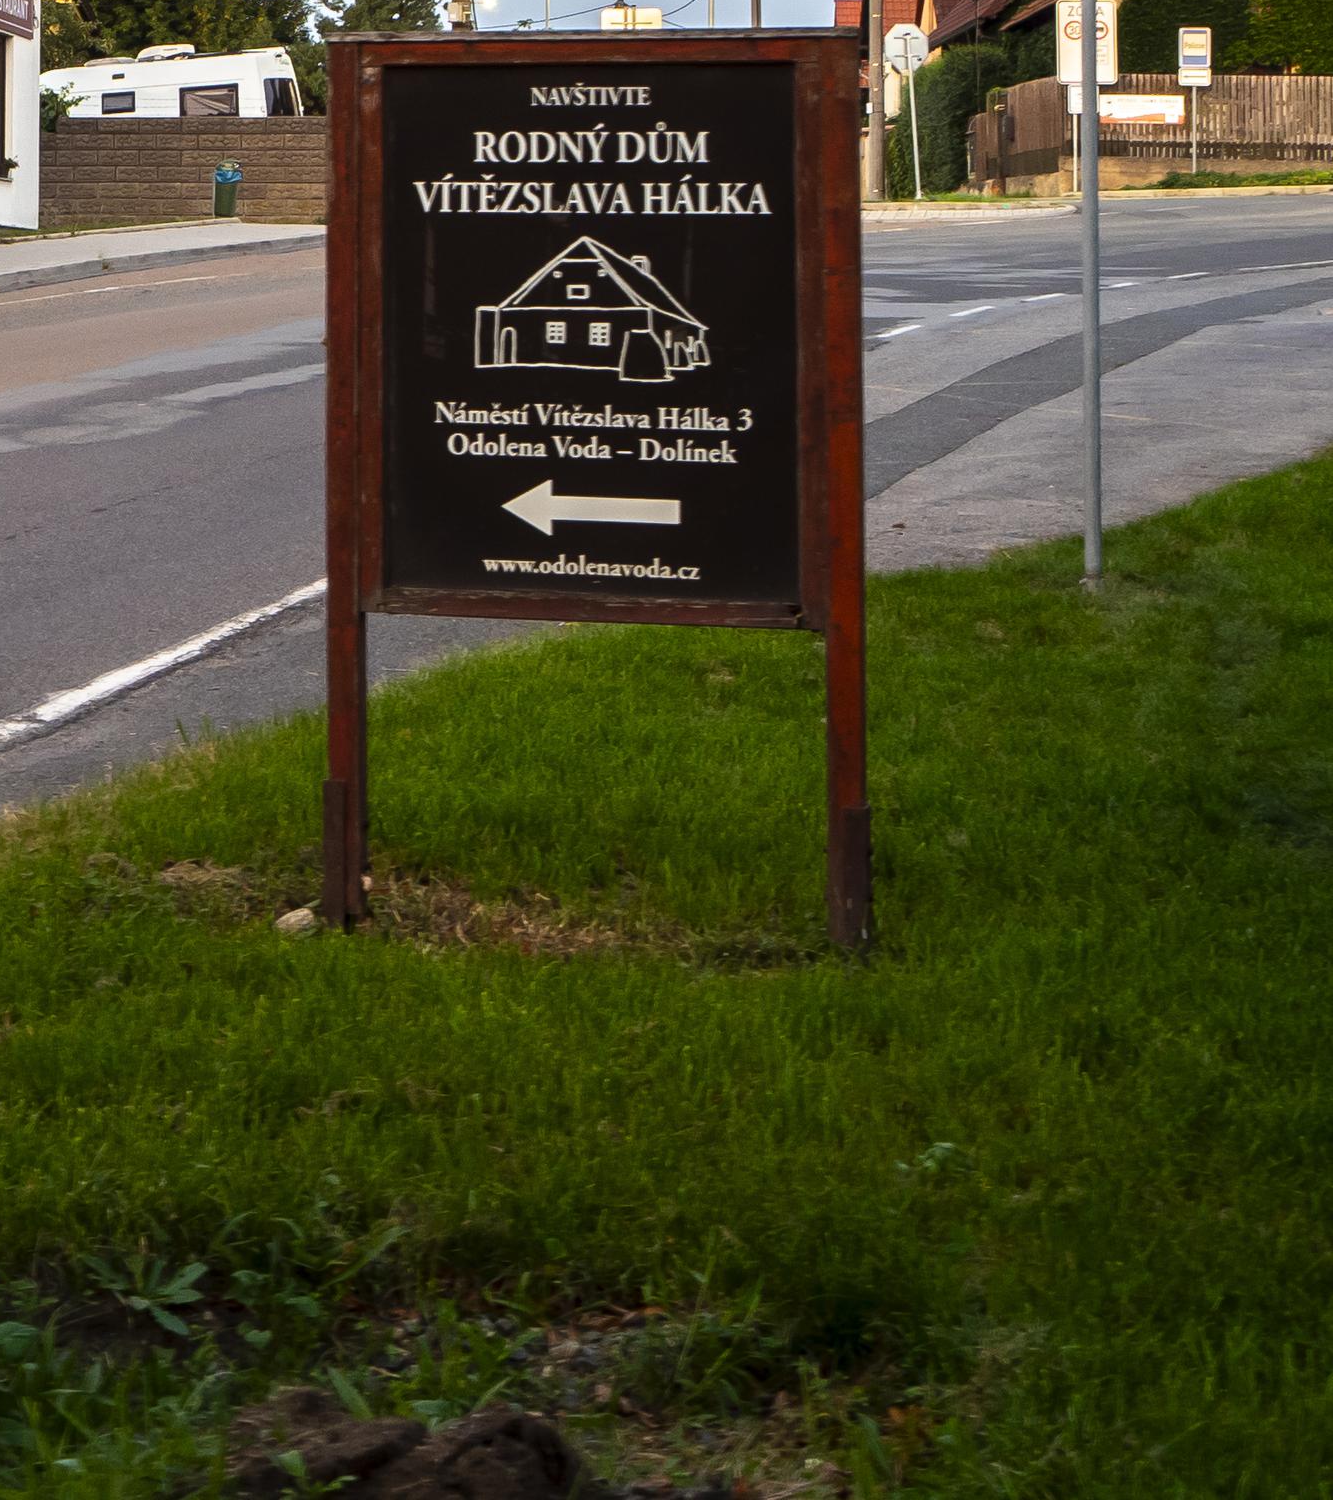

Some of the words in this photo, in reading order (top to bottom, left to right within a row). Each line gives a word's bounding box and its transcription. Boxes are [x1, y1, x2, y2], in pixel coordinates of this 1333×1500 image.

[1067, 5, 1105, 17] ZOA
[530, 82, 652, 106] NAVŠTIVTE
[473, 123, 610, 163] RODNÝ
[616, 121, 710, 163] DŮM
[412, 173, 635, 215] VÍTĚZSLAVA
[641, 174, 774, 215] HÁLKA
[434, 401, 530, 426] Náměstí
[535, 403, 651, 429] Vítězslava
[657, 407, 731, 431] Hálka
[736, 408, 753, 431] 3
[447, 433, 547, 457] Odolena
[553, 436, 612, 459] Voda
[638, 438, 739, 463] Dolínek
[482, 554, 701, 580] www.odolenavoda.cz
